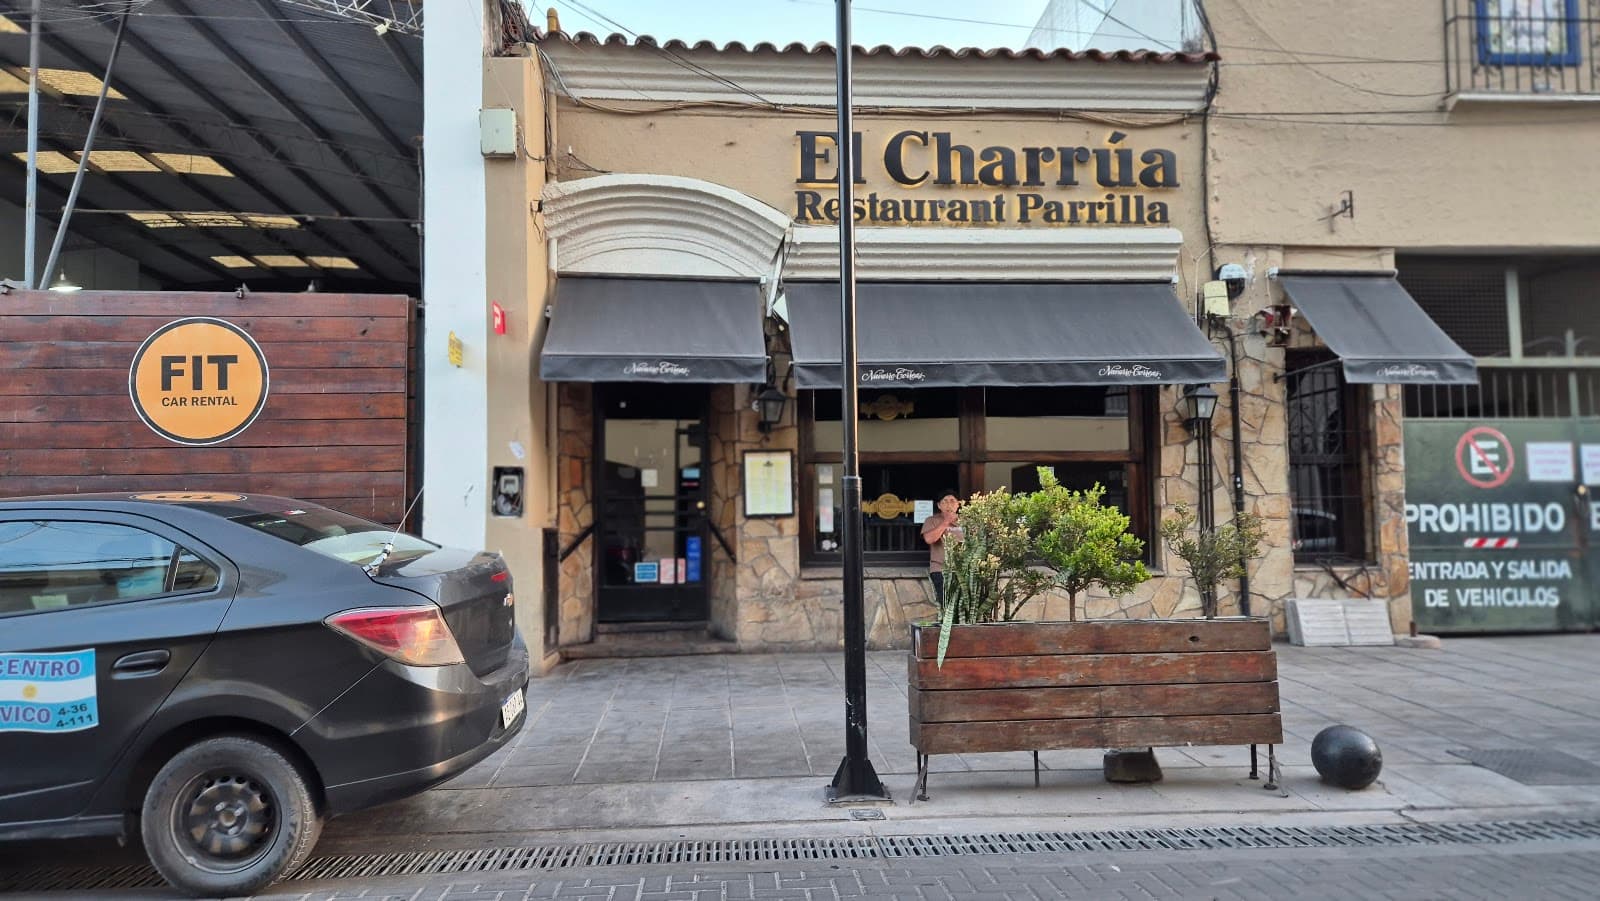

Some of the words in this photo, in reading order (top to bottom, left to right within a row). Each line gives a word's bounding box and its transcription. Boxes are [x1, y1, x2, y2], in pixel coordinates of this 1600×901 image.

[796, 131, 867, 184] El
[884, 130, 1180, 188] Charrúa
[795, 190, 1005, 222] Restaurant
[1017, 192, 1170, 224] Parrilla
[161, 355, 238, 391] FIT
[162, 397, 188, 407] CAR
[191, 396, 238, 407] RENTAL
[1405, 503, 1566, 532] PROHIBIDO
[1491, 561, 1505, 579] Y
[1507, 560, 1573, 579] SALIDA
[1424, 588, 1450, 607] DE
[1456, 586, 1560, 607] VEHICULOS
[0, 659, 81, 677] ENTRO
[57, 703, 88, 716] 4-36
[56, 714, 93, 728] 4-111
